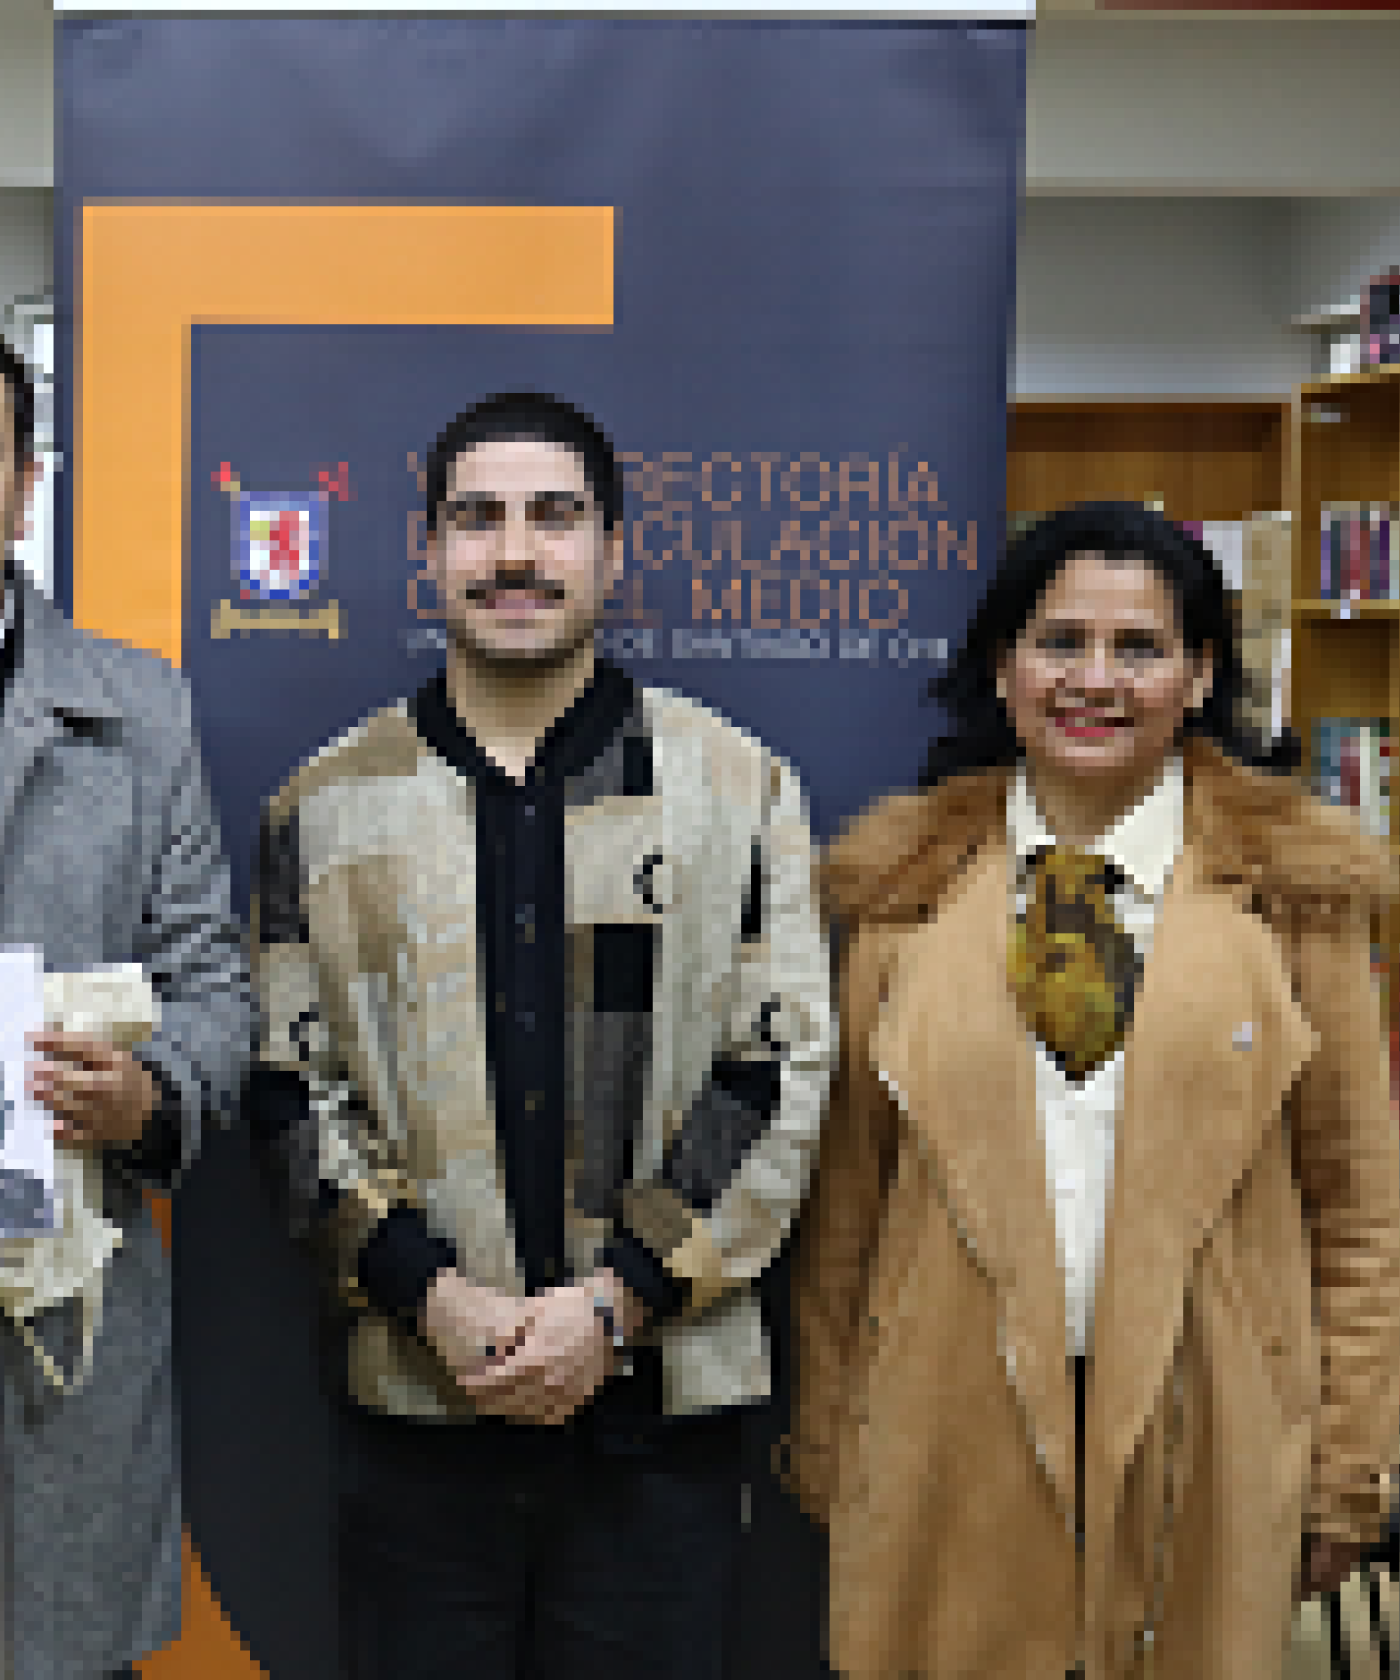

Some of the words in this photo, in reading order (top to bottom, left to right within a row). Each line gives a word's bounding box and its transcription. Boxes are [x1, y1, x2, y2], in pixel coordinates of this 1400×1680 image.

[406, 442, 946, 511] VRECTORÍA
[632, 510, 978, 571] CULACIÓN
[692, 572, 909, 629] MEDIO
